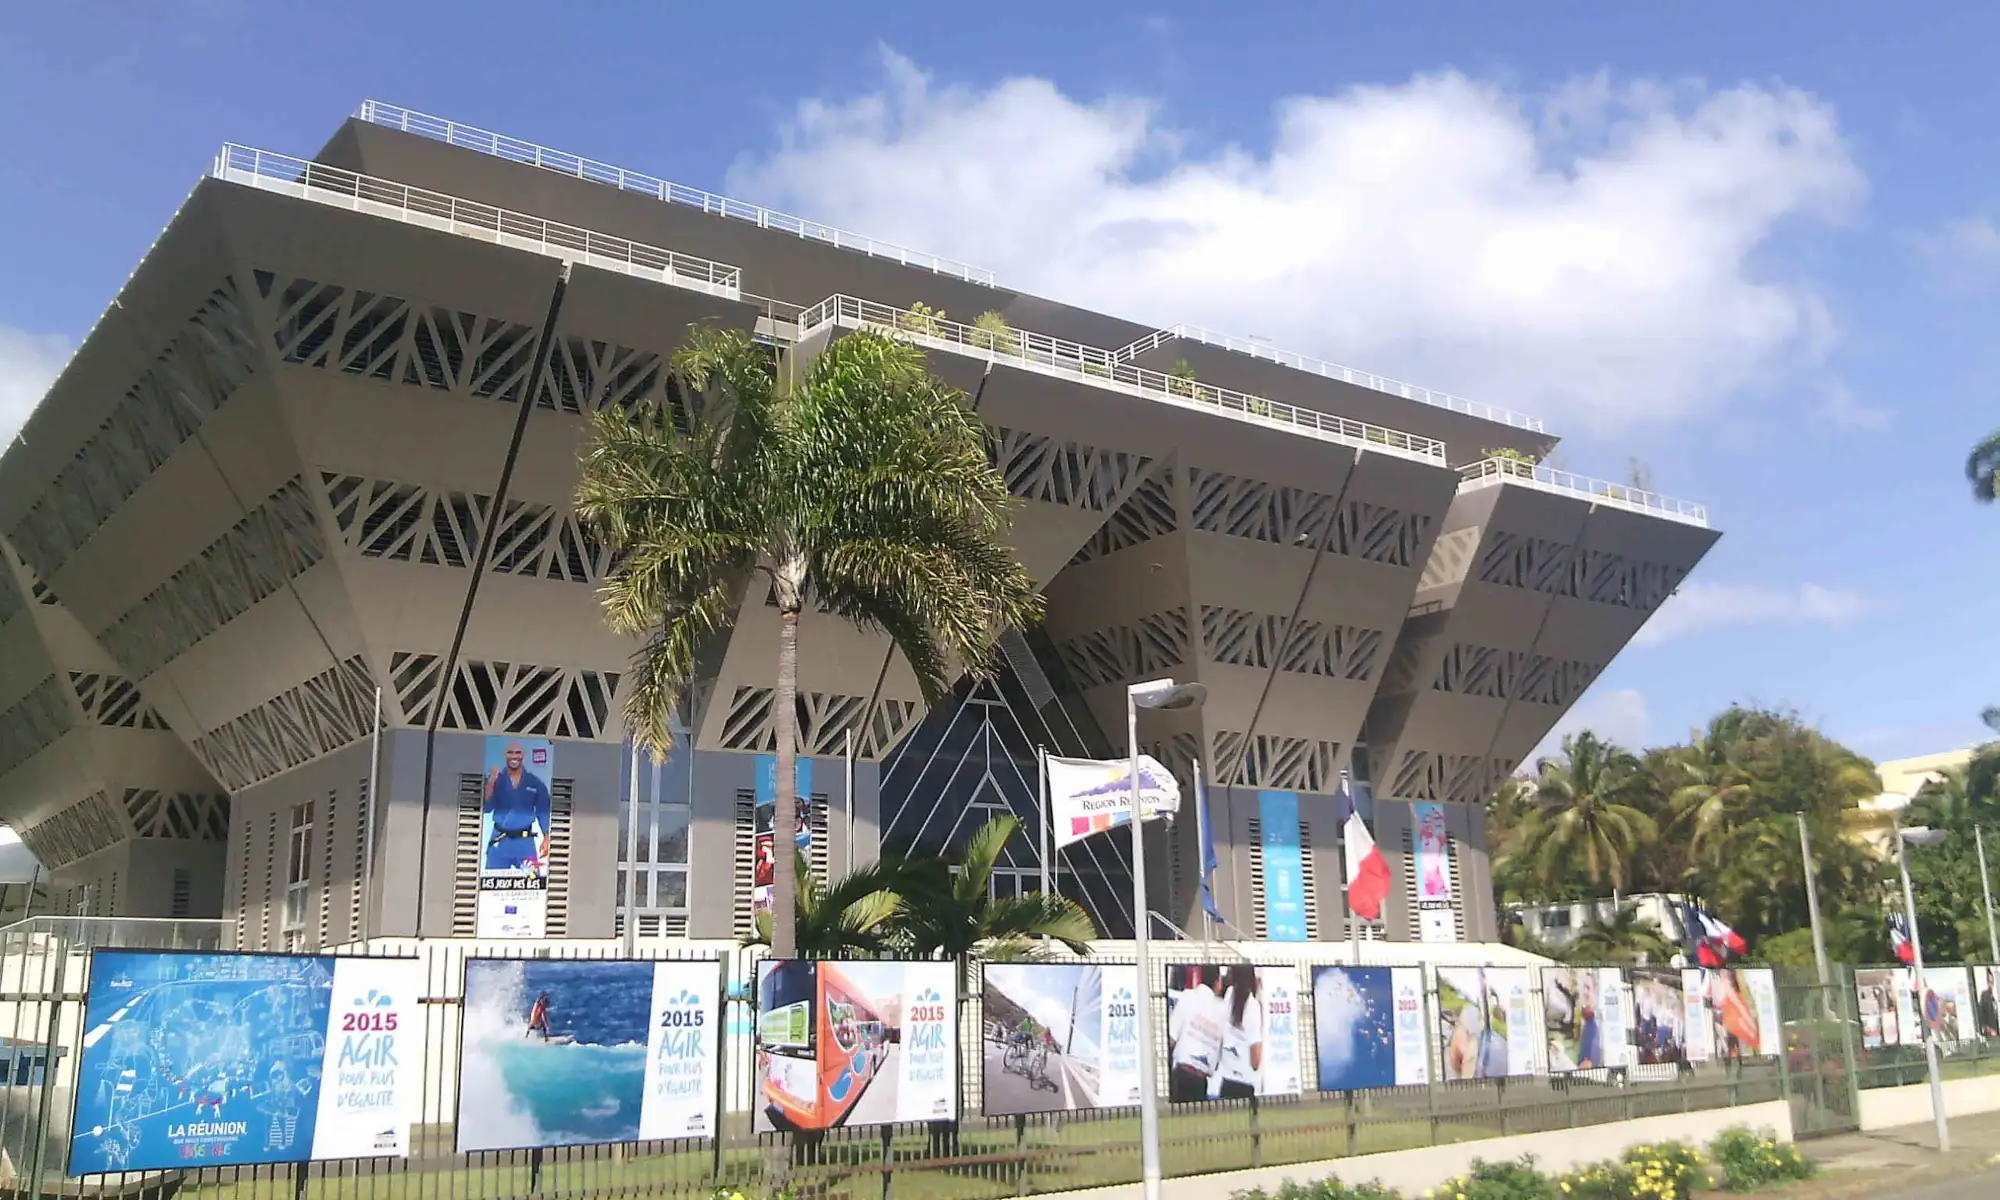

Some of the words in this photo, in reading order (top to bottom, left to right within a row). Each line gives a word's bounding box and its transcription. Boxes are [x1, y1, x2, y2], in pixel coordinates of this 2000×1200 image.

[1119, 796, 1160, 807] RENION
[910, 1006, 945, 1022] 2015
[1108, 1004, 1136, 1017] 2015
[1269, 1002, 1291, 1014] 2015
[342, 1012, 398, 1032] 2015
[661, 1010, 704, 1027] 2015
[658, 1029, 705, 1060] AGIR
[909, 1023, 946, 1050] AGIR
[337, 1033, 398, 1069] AGIR
[168, 1124, 185, 1138] LA
[187, 1119, 247, 1137] RÉUNION
